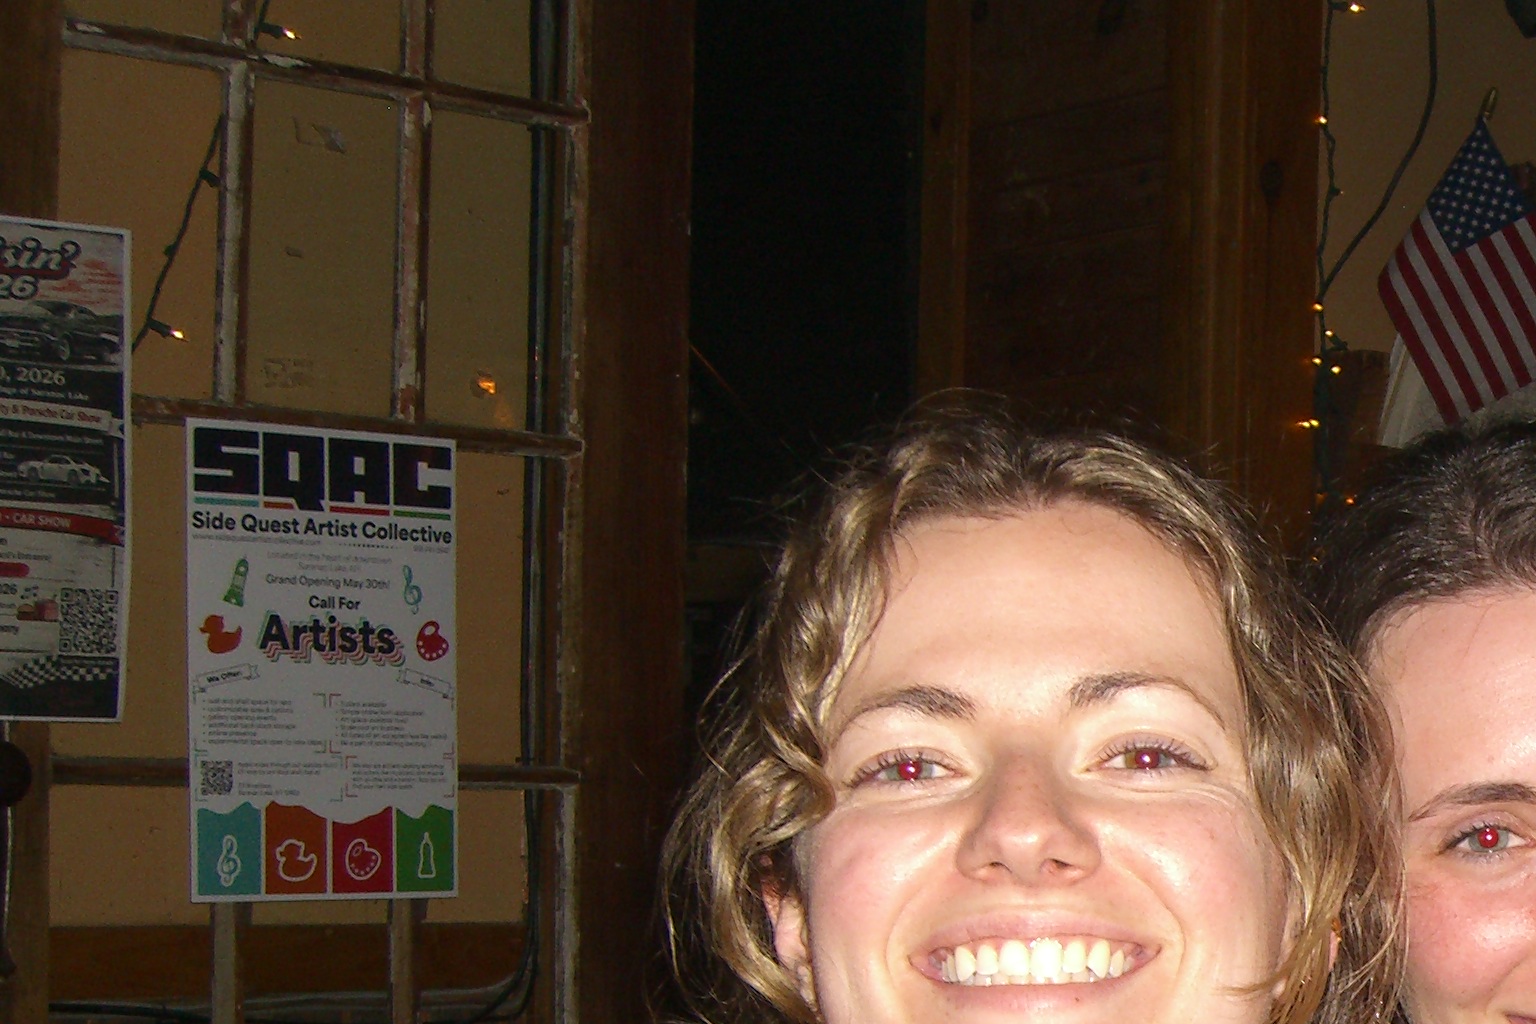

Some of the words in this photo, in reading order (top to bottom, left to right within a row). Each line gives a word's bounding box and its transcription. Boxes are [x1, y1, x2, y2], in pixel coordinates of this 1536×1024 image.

[16, 366, 66, 386] 2026
[194, 427, 451, 511] SQAC
[13, 512, 36, 525] CAR
[39, 514, 72, 529] SHOW
[192, 511, 236, 530] Side
[241, 513, 300, 533] Quest
[303, 518, 358, 538] Artist
[362, 521, 453, 544] Collective
[265, 573, 297, 585] Grand
[299, 575, 341, 589] Opening
[343, 578, 363, 589] May
[308, 595, 335, 609] Call
[338, 597, 360, 610] For
[259, 613, 400, 656] Artists
